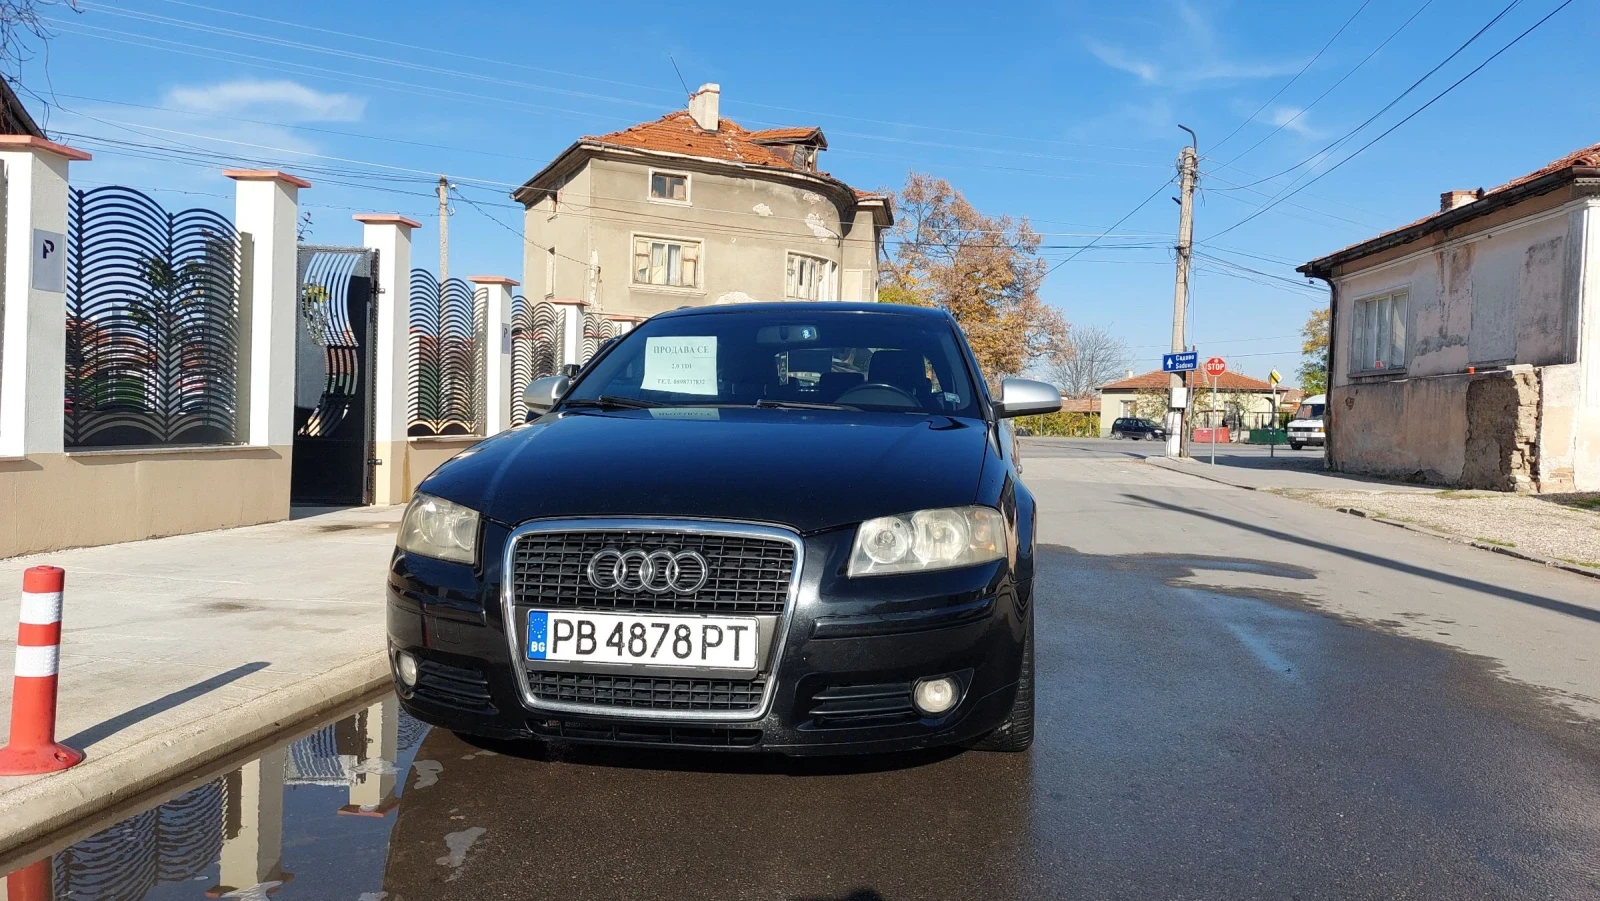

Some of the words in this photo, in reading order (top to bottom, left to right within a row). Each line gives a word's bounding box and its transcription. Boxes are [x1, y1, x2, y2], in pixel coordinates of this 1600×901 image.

[42, 239, 55, 259] P
[653, 345, 695, 355] ПРОДАВА
[697, 345, 709, 354] СЕ
[1207, 363, 1225, 371] STOP
[552, 618, 598, 656] PB
[605, 620, 692, 660] 4878
[700, 624, 749, 661] PT
[530, 641, 546, 653] BG
